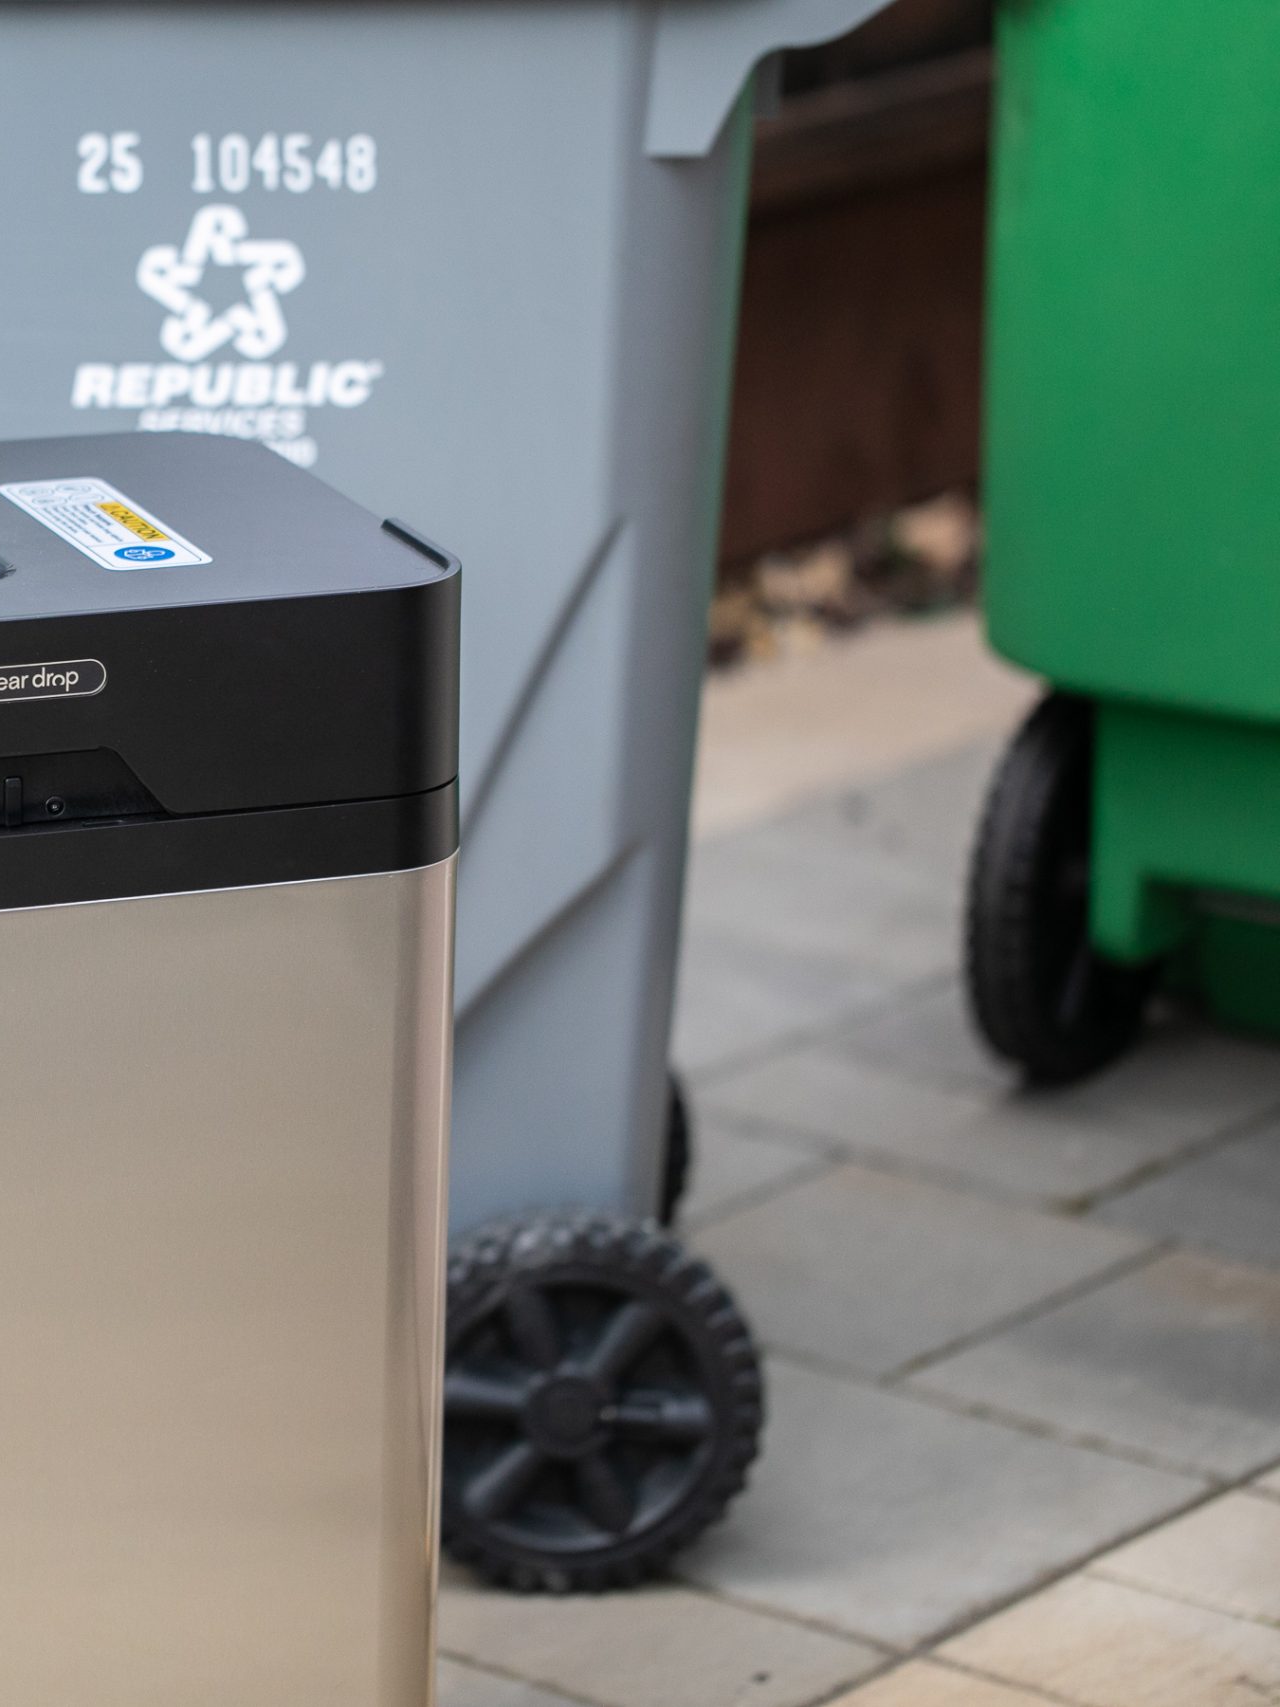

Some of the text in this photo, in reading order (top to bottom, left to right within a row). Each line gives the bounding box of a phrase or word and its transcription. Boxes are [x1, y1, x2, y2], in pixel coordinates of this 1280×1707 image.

[77, 131, 377, 193] 25 104548
[71, 361, 374, 408] REPUBLIC
[110, 508, 162, 540] CAUTION
[31, 667, 79, 692] drop
